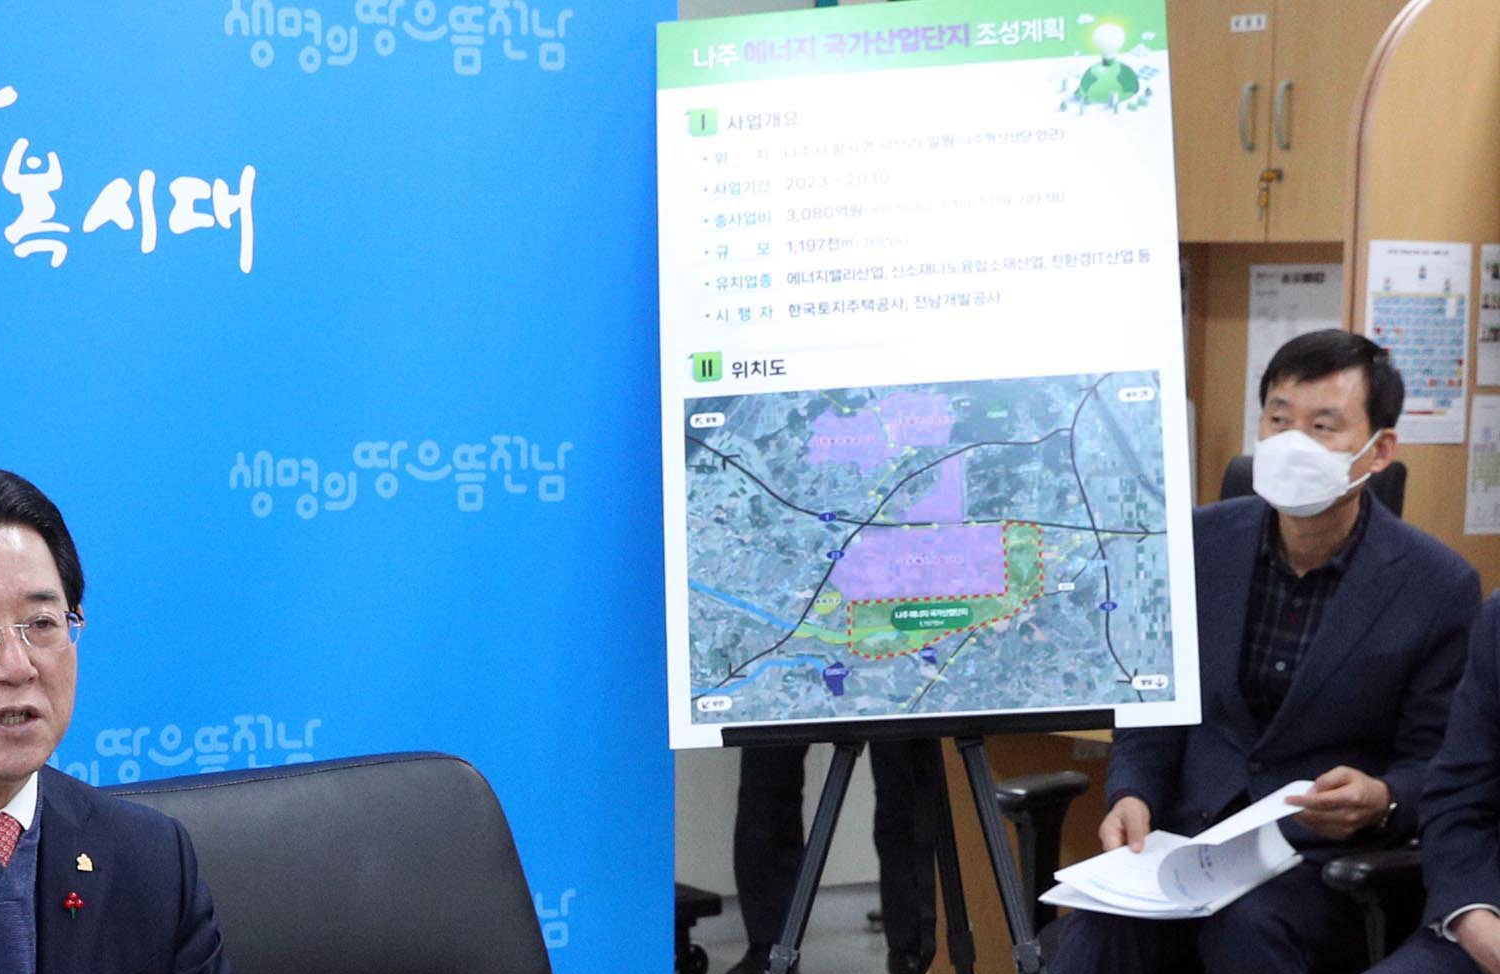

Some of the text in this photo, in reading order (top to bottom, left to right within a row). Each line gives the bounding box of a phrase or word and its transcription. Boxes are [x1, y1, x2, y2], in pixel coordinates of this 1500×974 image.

[692, 17, 1066, 70] 나주 에너지 국가산업단지 조성계획
[727, 112, 800, 131] 사업개요
[731, 357, 787, 381] 위치도
